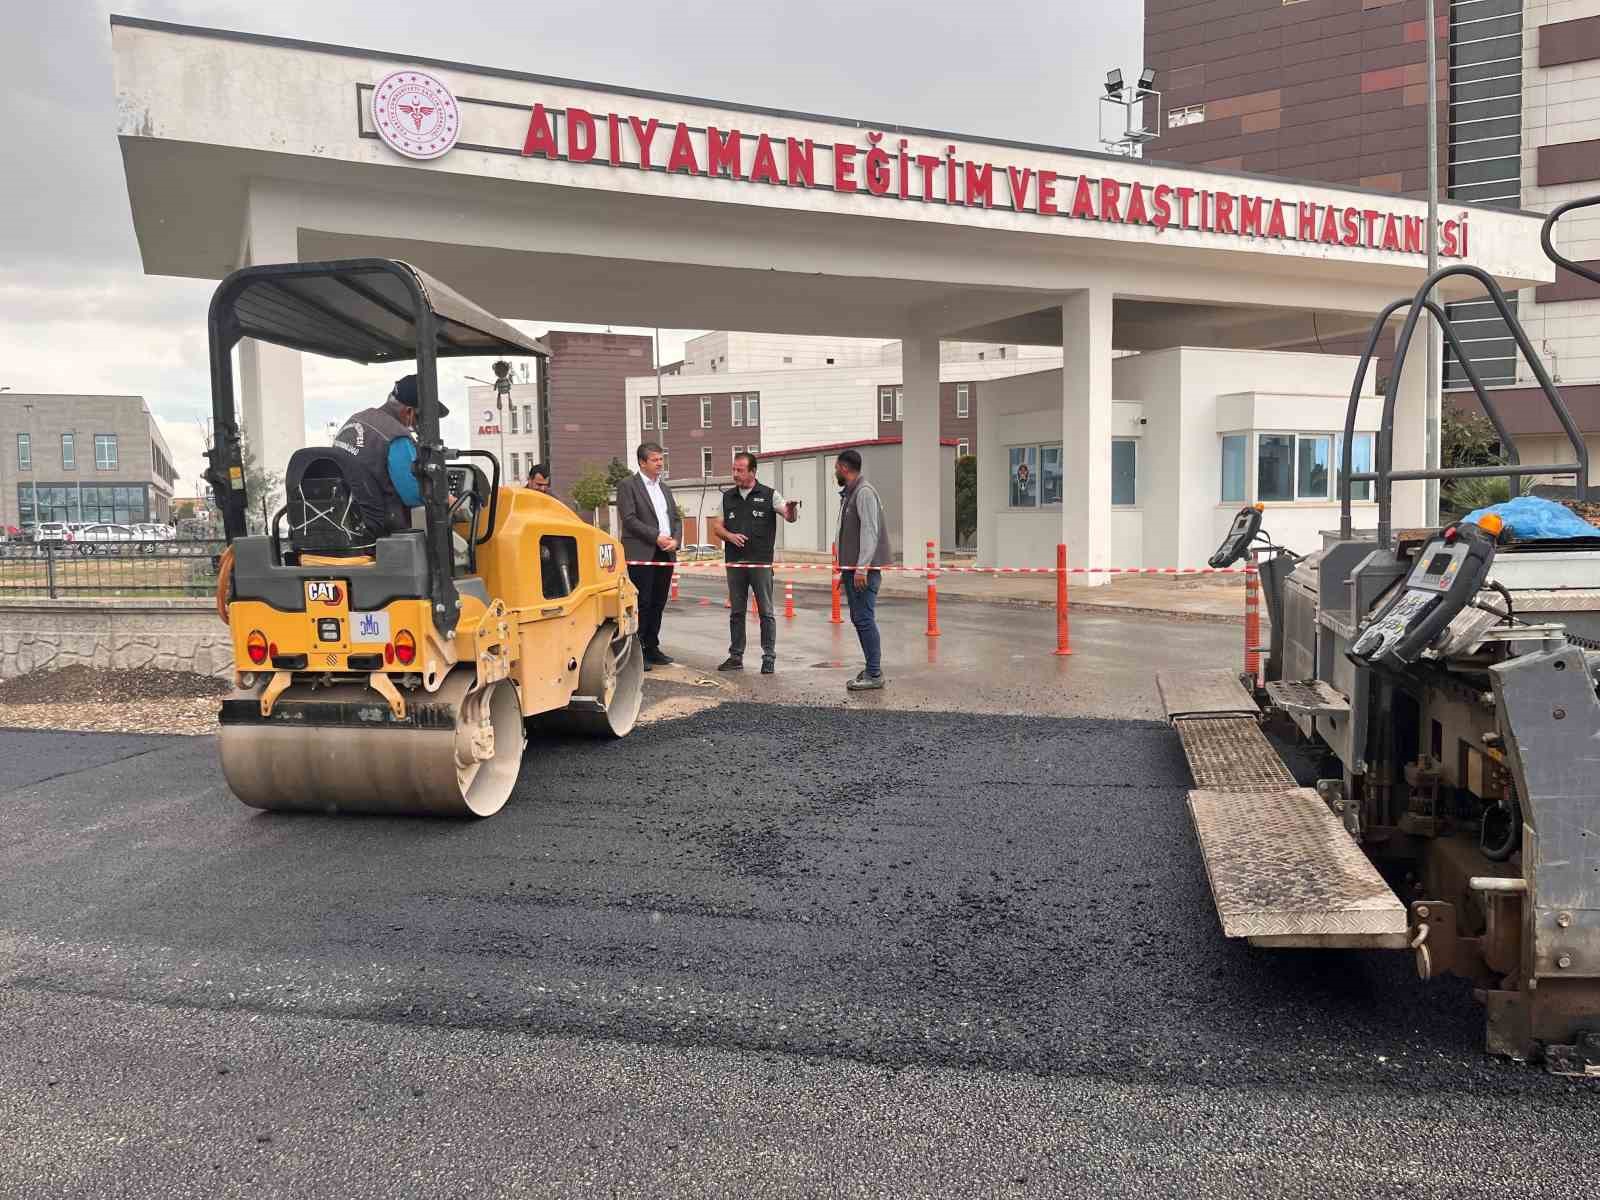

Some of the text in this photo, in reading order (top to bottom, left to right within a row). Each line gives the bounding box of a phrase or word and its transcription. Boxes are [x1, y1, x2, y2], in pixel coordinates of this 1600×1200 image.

[520, 103, 815, 188] ADIYAMAN
[833, 131, 993, 208] EĞİTİM
[1008, 166, 1058, 215] VE
[1069, 175, 1288, 239] ARAŞTIRMA
[1297, 201, 1469, 258] HASTANSİ
[600, 545, 614, 568] CAT
[308, 583, 336, 601] CAT
